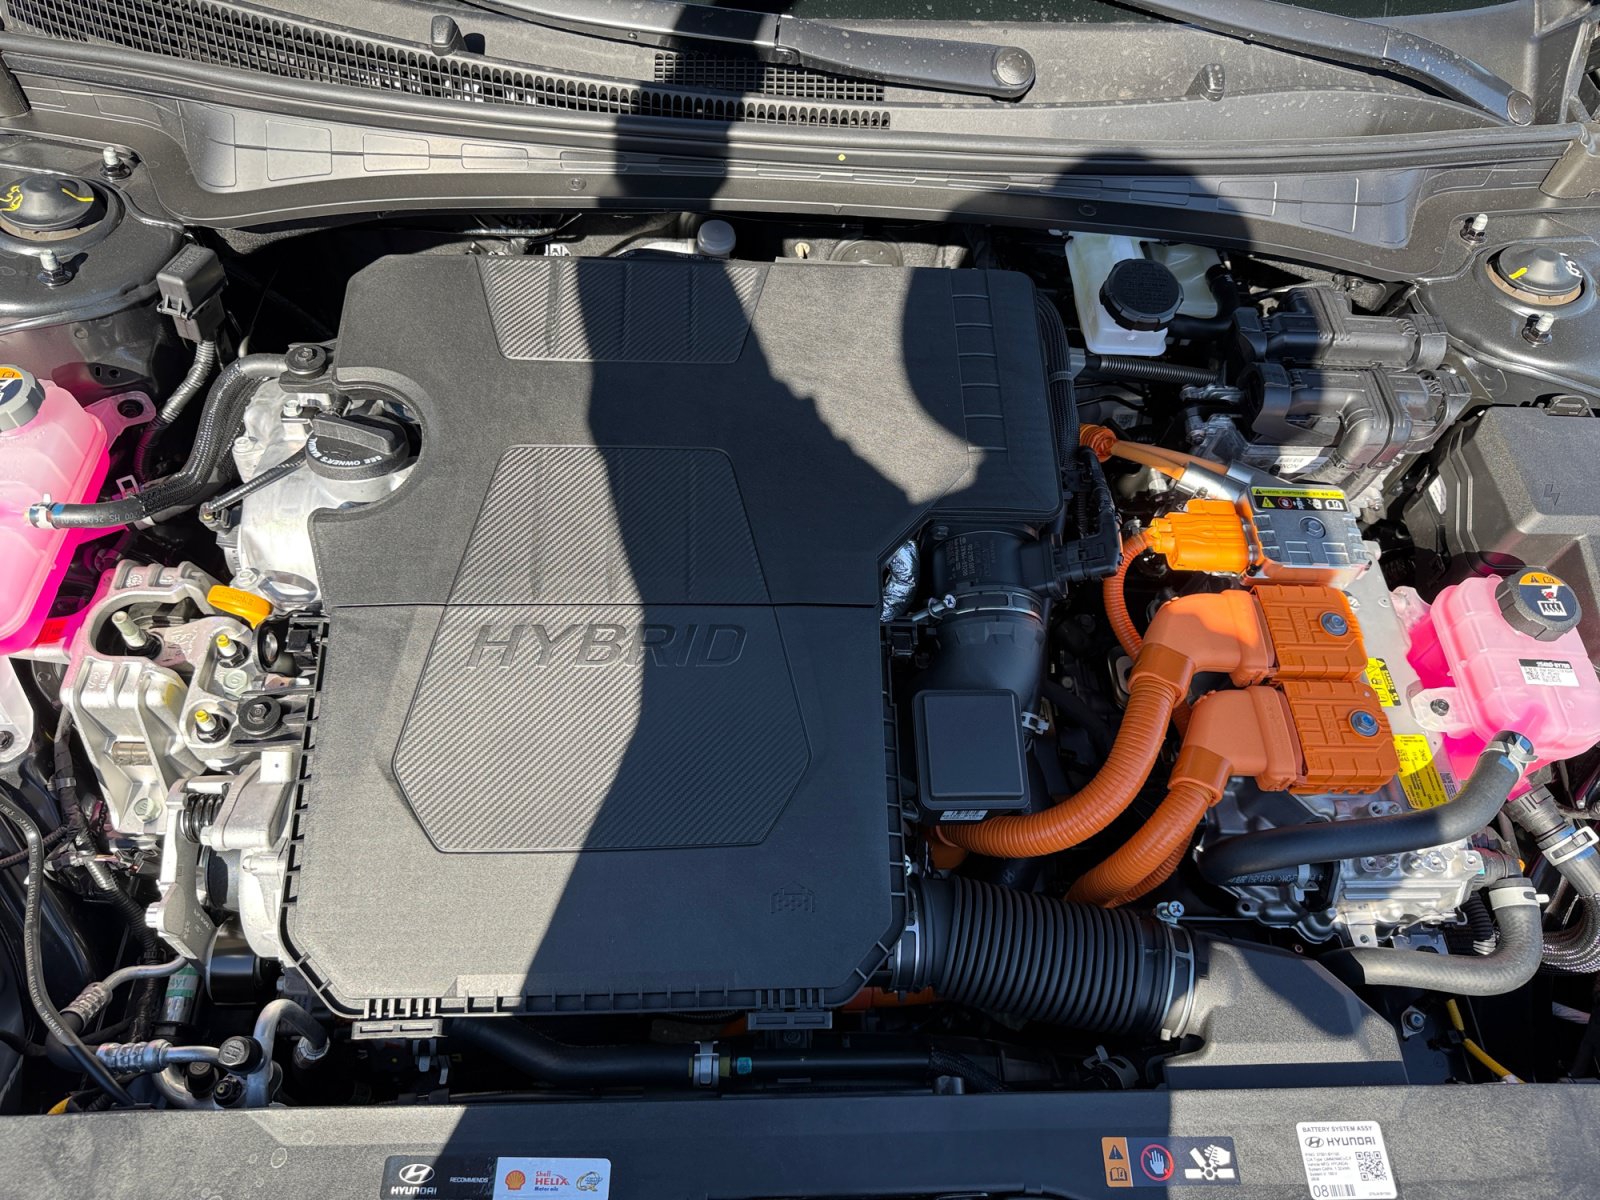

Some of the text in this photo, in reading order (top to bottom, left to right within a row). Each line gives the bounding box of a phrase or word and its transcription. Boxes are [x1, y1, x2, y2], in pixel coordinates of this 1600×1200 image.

[320, 456, 361, 466] OWNER'S
[363, 455, 382, 464] SEE
[466, 623, 748, 668] HYBRID
[28, 975, 43, 1008] RESERVOIR
[1326, 1136, 1376, 1146] HYUNDAI
[535, 1170, 551, 1178] Shell
[449, 1176, 489, 1184] RECOMMENDS
[535, 1176, 568, 1186] HELIX
[390, 1186, 438, 1195] HYUNDAI
[1312, 1184, 1329, 1198] 08
